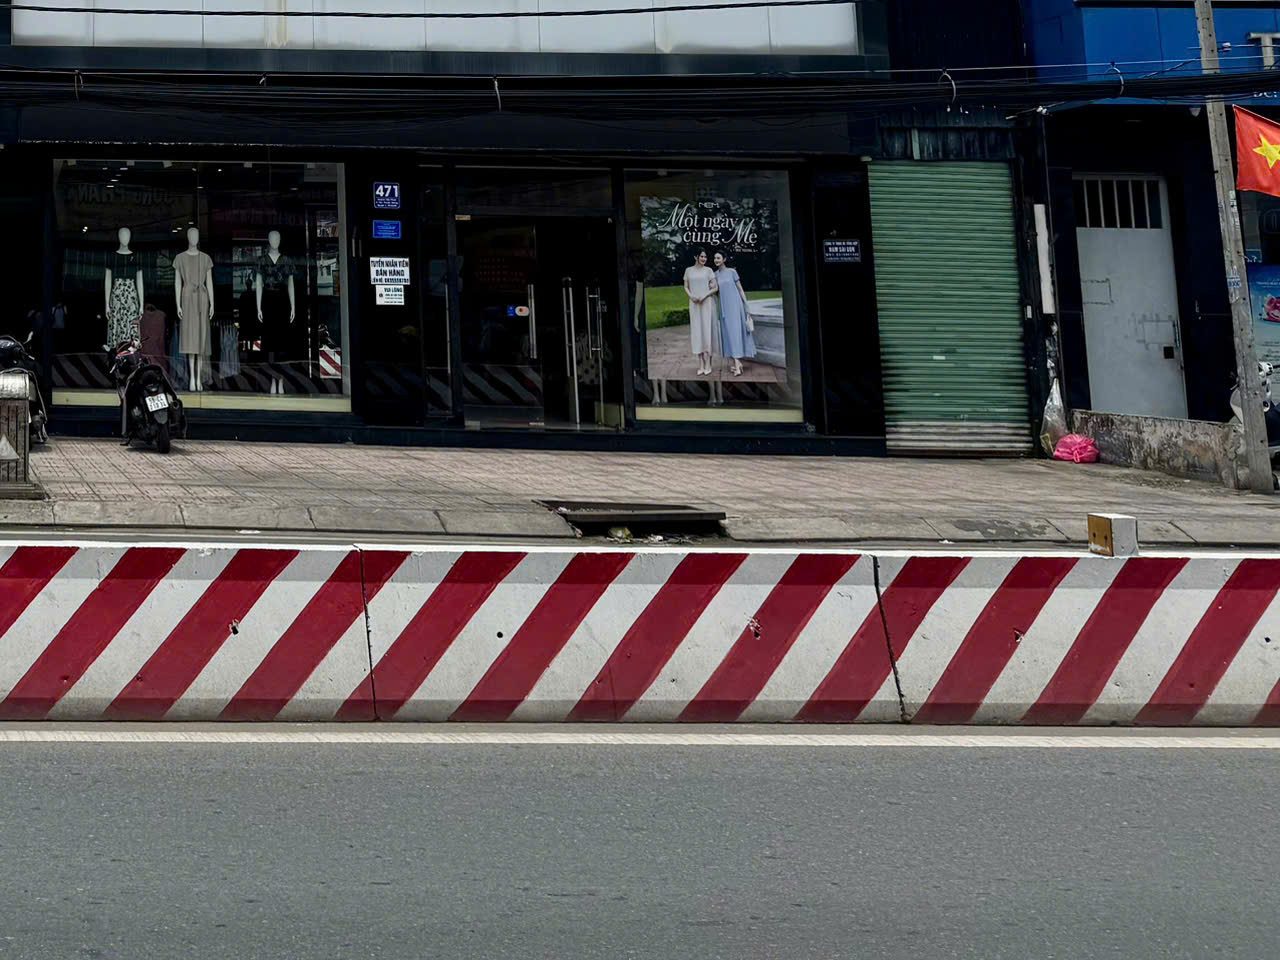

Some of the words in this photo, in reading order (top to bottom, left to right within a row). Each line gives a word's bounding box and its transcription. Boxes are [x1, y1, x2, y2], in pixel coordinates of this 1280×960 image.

[376, 185, 398, 197] 471
[656, 203, 700, 229] Một
[703, 214, 737, 231] ngày
[683, 228, 721, 246] cùng
[722, 219, 758, 246] Mẹ
